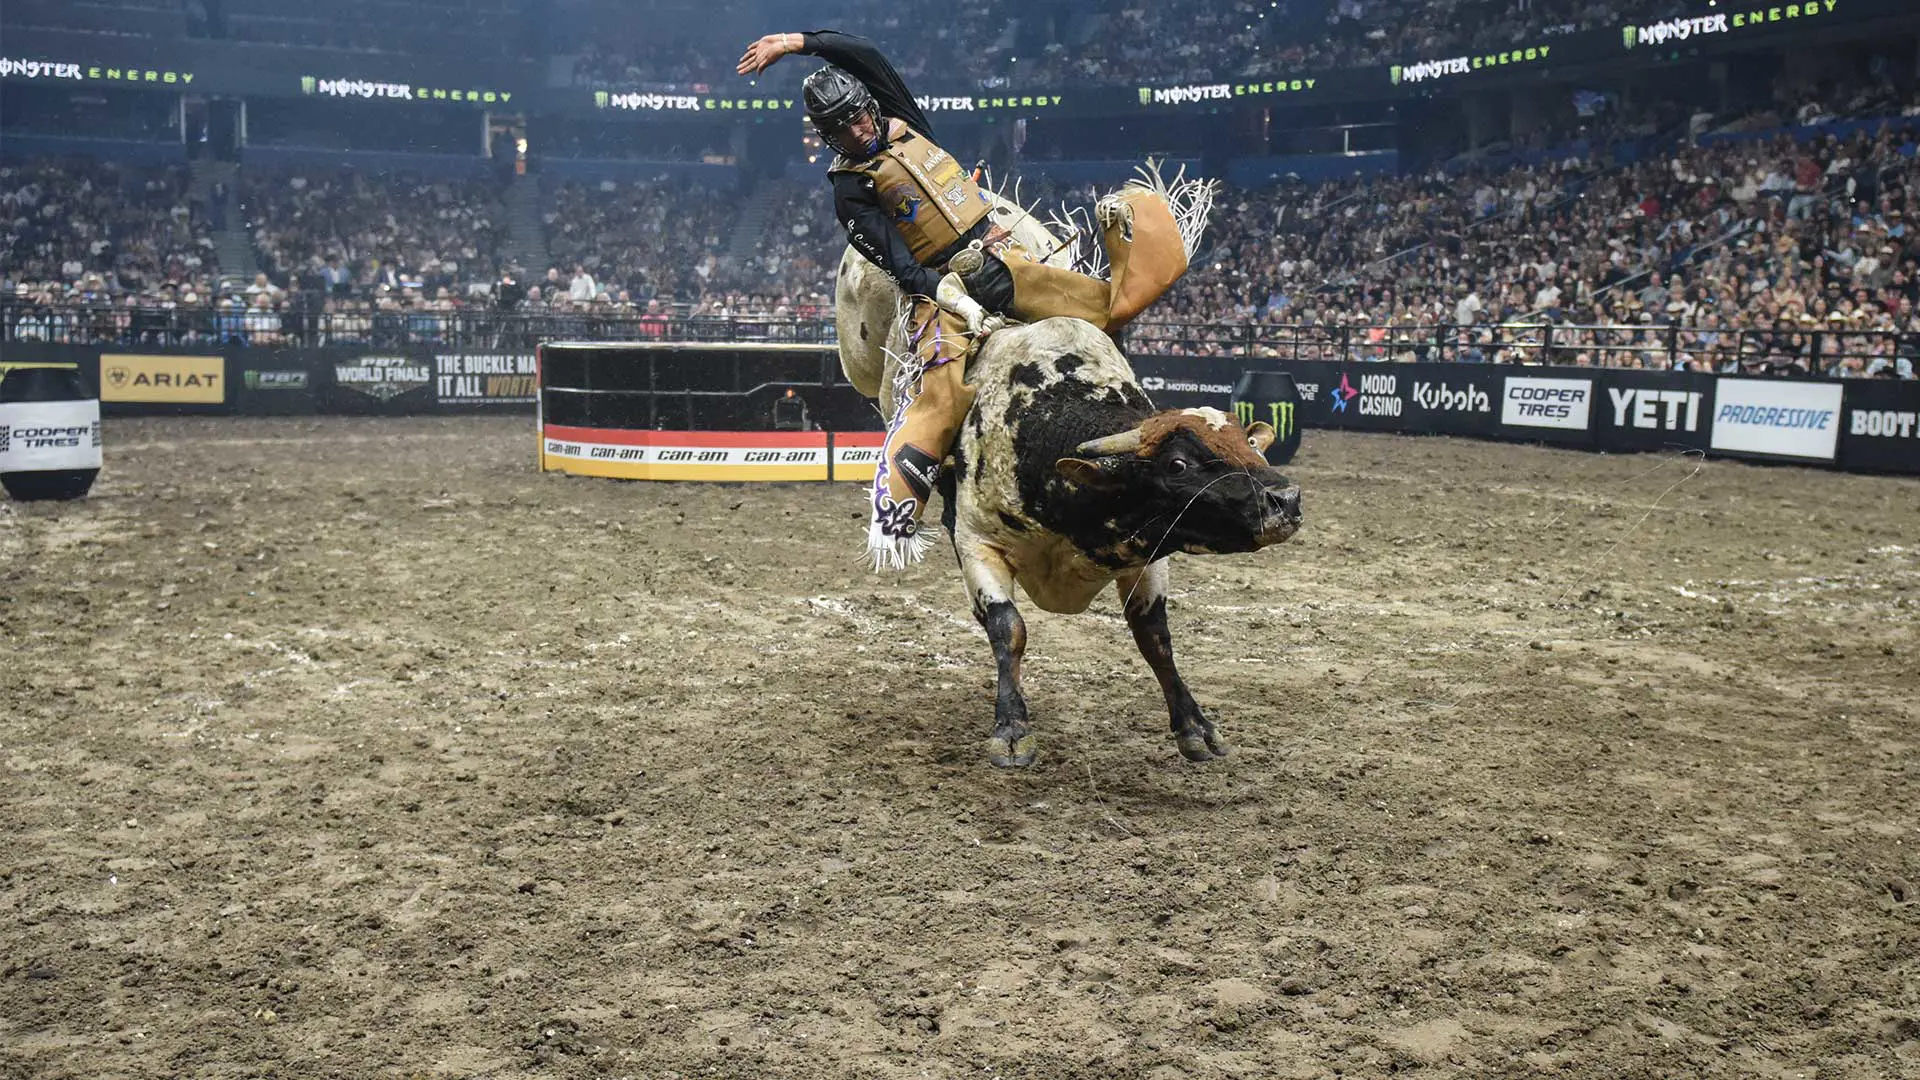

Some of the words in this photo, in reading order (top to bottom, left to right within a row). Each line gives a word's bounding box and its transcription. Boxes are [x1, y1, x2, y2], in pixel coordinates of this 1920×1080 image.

[1638, 13, 1728, 45] MONSTER
[1733, 0, 1836, 28] ENERGY
[0, 57, 83, 80] ONSTER
[89, 67, 193, 84] ENERGY
[1402, 56, 1470, 82] MONSTER
[1472, 45, 1549, 69] ENERGY
[319, 78, 413, 100] MONSTER
[417, 87, 511, 103] ENERGY
[1154, 84, 1232, 105] MONSTER
[1235, 79, 1316, 96] ENERGY
[611, 93, 700, 111] MONSTER
[705, 99, 793, 109] ENERGY
[913, 95, 974, 112] NSTER
[978, 96, 1062, 108] ENERGY
[436, 355, 462, 374] THE
[464, 355, 515, 374] BUCKLE
[517, 355, 537, 374] MA
[133, 371, 219, 388] ARIAT
[335, 366, 383, 382] WORLD
[385, 365, 430, 382] FINALS
[437, 375, 453, 397] IT
[455, 375, 483, 397] ALL
[1167, 383, 1198, 392] MOTOR
[1199, 384, 1233, 394] RACING
[1296, 383, 1319, 393] RCE
[1360, 374, 1396, 395] MODO
[1299, 391, 1315, 401] VE
[1412, 381, 1489, 412] Kubota
[1508, 386, 1586, 403] COOPER
[1359, 395, 1402, 417] CASINO
[1517, 402, 1571, 418] TIRES
[1608, 387, 1703, 432] YETI
[1717, 404, 1834, 431] PROGRESSIVE
[1850, 408, 1916, 438] BOOT
[12, 425, 89, 439] COOPER
[23, 437, 79, 448] TIRES
[547, 441, 581, 456] can-am
[590, 446, 645, 460] can-am
[657, 449, 728, 461] can-am
[743, 449, 816, 462] can-am
[841, 450, 882, 461] can-a
